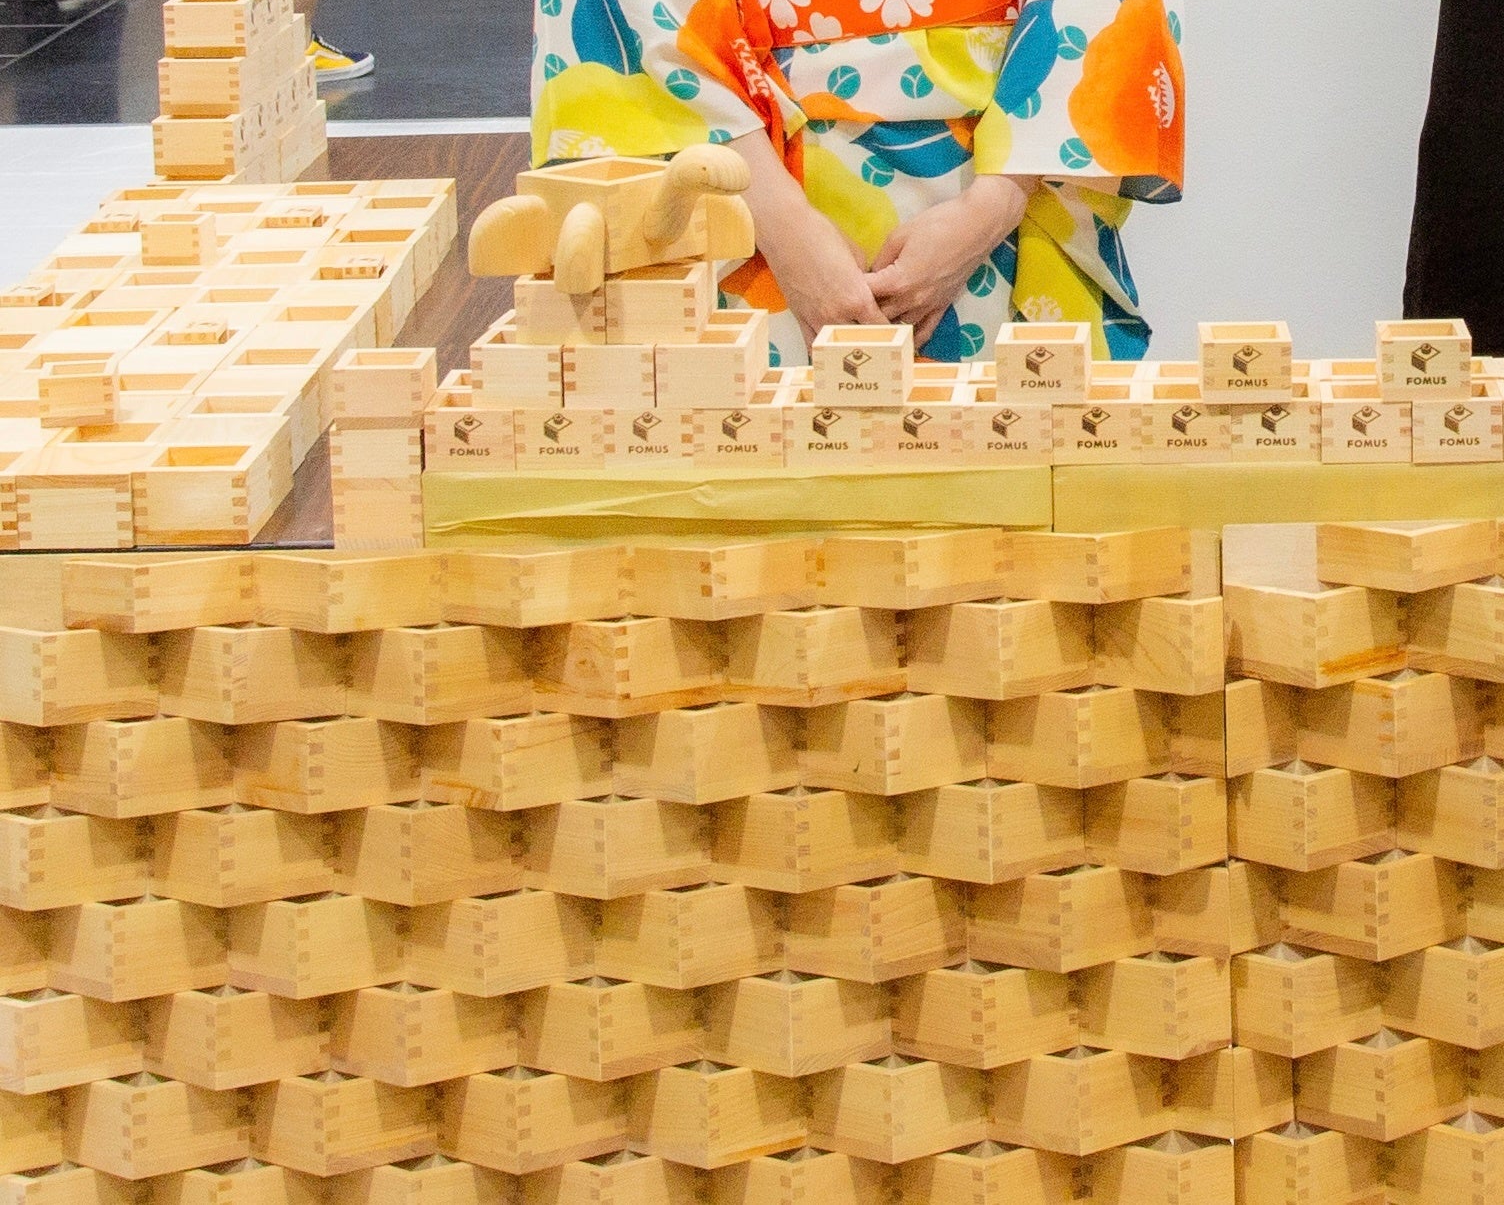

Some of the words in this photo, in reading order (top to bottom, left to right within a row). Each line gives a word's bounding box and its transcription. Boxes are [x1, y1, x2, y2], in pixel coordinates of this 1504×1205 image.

[1020, 379, 1062, 389] FOMUS
[1227, 378, 1269, 388] FOMUS
[1406, 376, 1447, 386] FOMUS
[838, 382, 879, 391] FOMUS
[807, 441, 849, 451] FOMUS
[897, 441, 939, 451] FOMUS
[986, 441, 1028, 451] FOMUS
[1076, 439, 1118, 449] FOMUS
[1166, 438, 1208, 448] FOMUS
[1255, 437, 1297, 447] FOMUS
[1346, 438, 1388, 448] FOMUS
[1439, 436, 1481, 447] FOMUS
[449, 447, 491, 457] FOMUS
[538, 446, 580, 456] FOMUS
[627, 445, 669, 454] FOMUS
[717, 444, 759, 454] FOMUS
